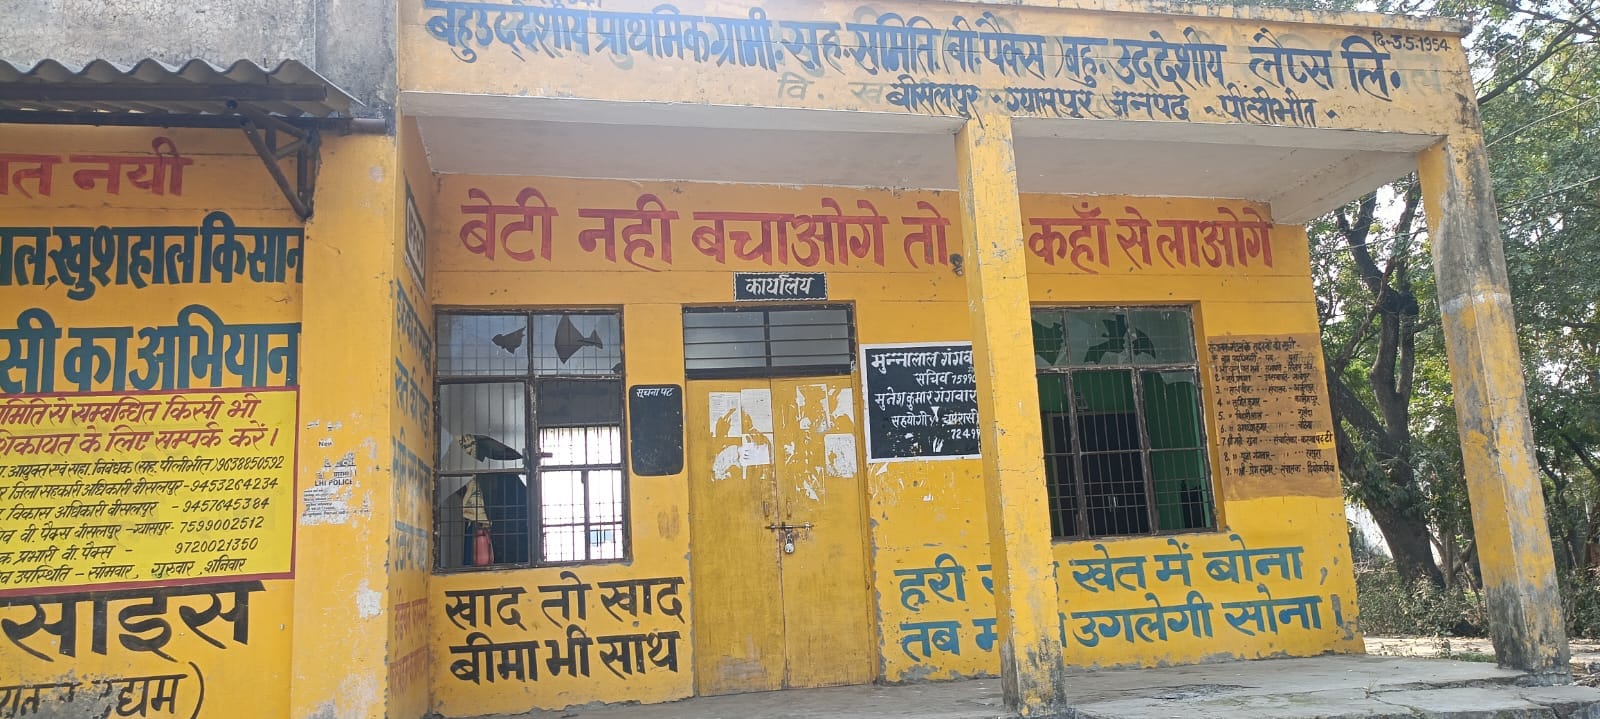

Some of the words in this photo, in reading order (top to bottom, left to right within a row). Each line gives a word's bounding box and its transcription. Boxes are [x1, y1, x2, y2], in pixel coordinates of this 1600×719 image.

[70, 137, 193, 196] नयी
[49, 225, 198, 301] खुशहाल
[200, 211, 304, 284] किसान
[459, 187, 559, 262] बेटी
[578, 193, 680, 272] नही
[691, 197, 889, 268] बचाओगे
[1028, 202, 1111, 274] कहाँ
[1116, 206, 1152, 270] से
[1156, 207, 1274, 269] लाओगे
[63, 327, 133, 393] का
[129, 304, 302, 391] अभियान
[913, 369, 953, 386] सचिव
[50, 398, 73, 426] से
[72, 396, 162, 426] सम्बन्धित
[162, 395, 224, 424] किसी
[227, 393, 262, 420] भी
[636, 388, 660, 398] सूचना
[79, 425, 103, 453] के
[104, 424, 153, 453] लिए
[155, 421, 223, 451] सम्पर्क
[6, 503, 56, 521] विकास
[55, 500, 109, 519] अधिकारी
[8, 481, 42, 500] जिला
[40, 480, 84, 500] सहकारी
[82, 478, 134, 498] अधिकारी
[445, 586, 528, 631] खाद
[538, 571, 593, 629] तो
[597, 576, 686, 625] खाद
[894, 553, 966, 612] हरी
[1069, 544, 1148, 592] खेत
[1154, 539, 1194, 587] में
[1203, 534, 1304, 584] बोना
[900, 620, 962, 662] तब
[1072, 591, 1214, 647] उगलेगी
[1221, 583, 1323, 636] सोना
[449, 631, 540, 685] बीमा
[546, 624, 594, 678] भी
[597, 630, 682, 680] साथ
